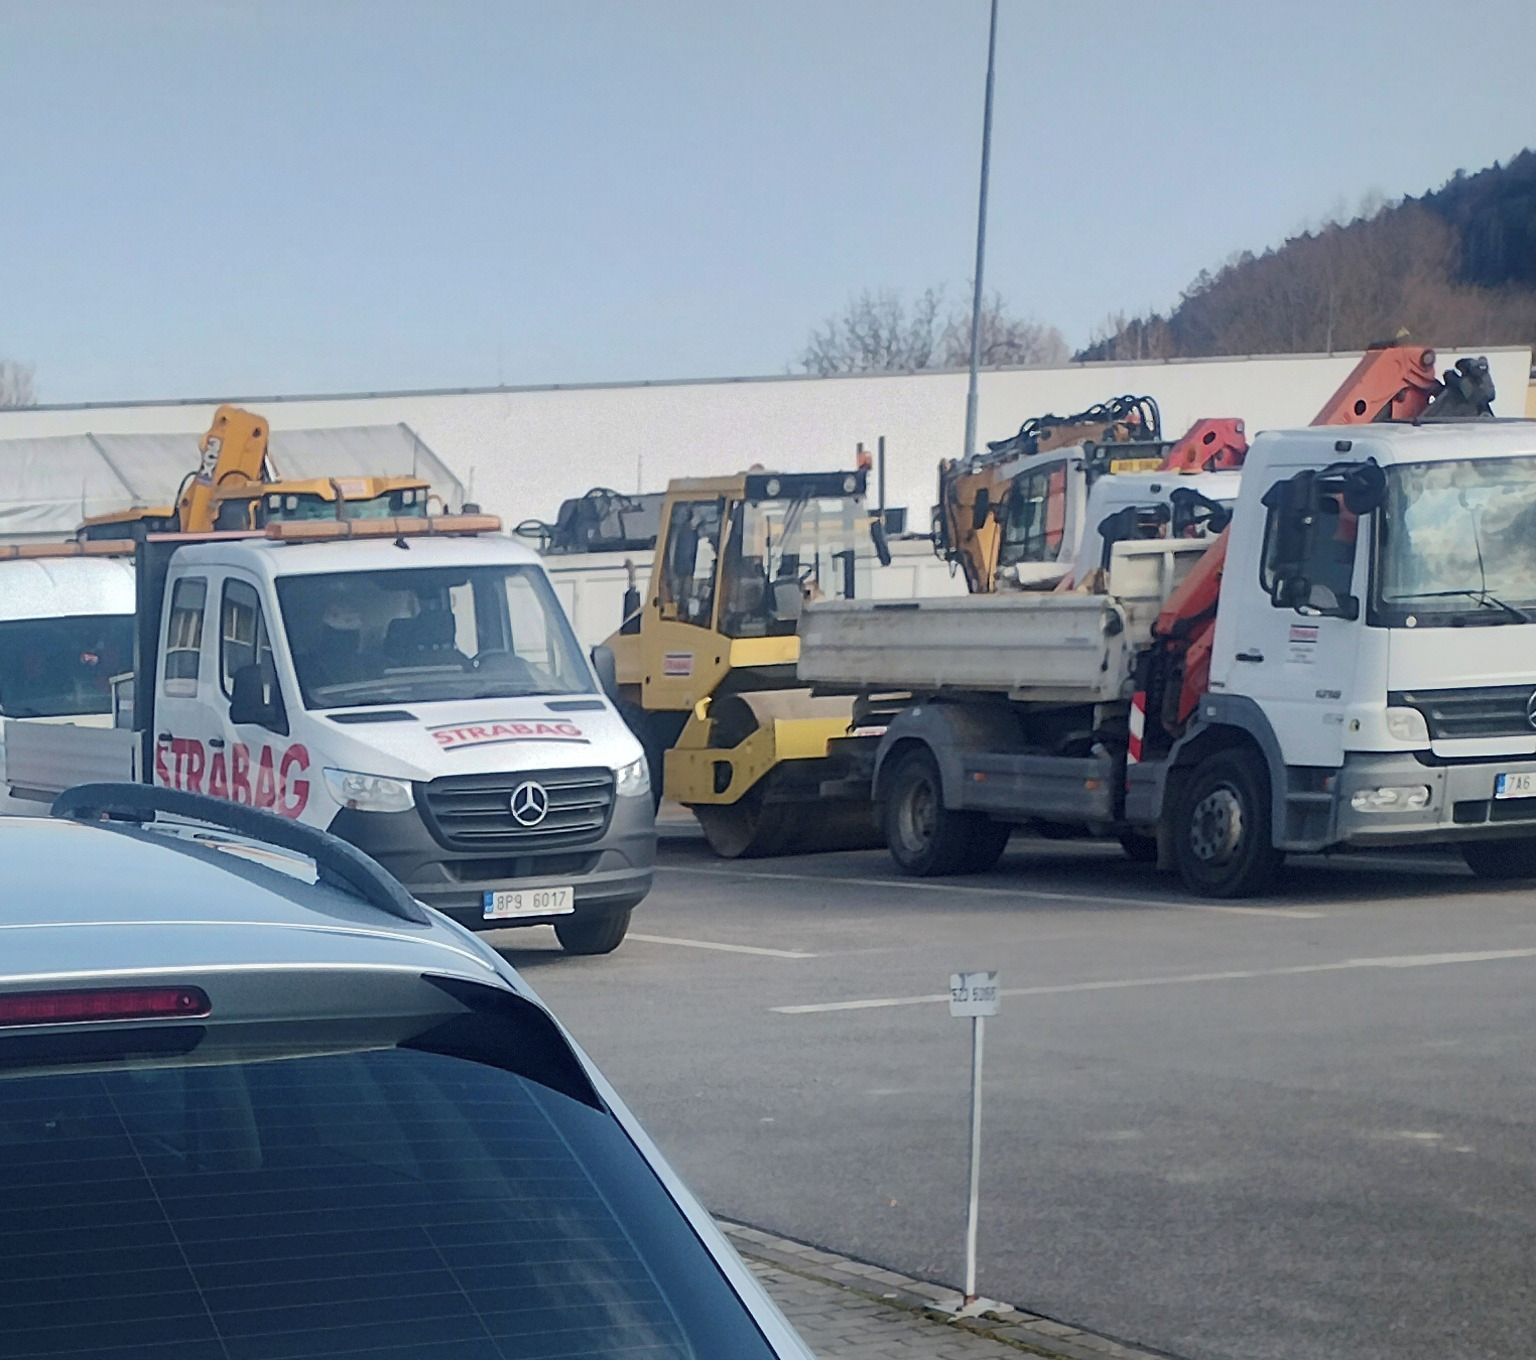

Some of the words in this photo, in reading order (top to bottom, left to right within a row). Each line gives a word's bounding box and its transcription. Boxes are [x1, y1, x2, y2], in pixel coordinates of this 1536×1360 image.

[432, 723, 582, 745] STRABAG
[156, 736, 310, 820] STRABAG
[497, 894, 522, 911] 8P9
[533, 891, 566, 908] 6017
